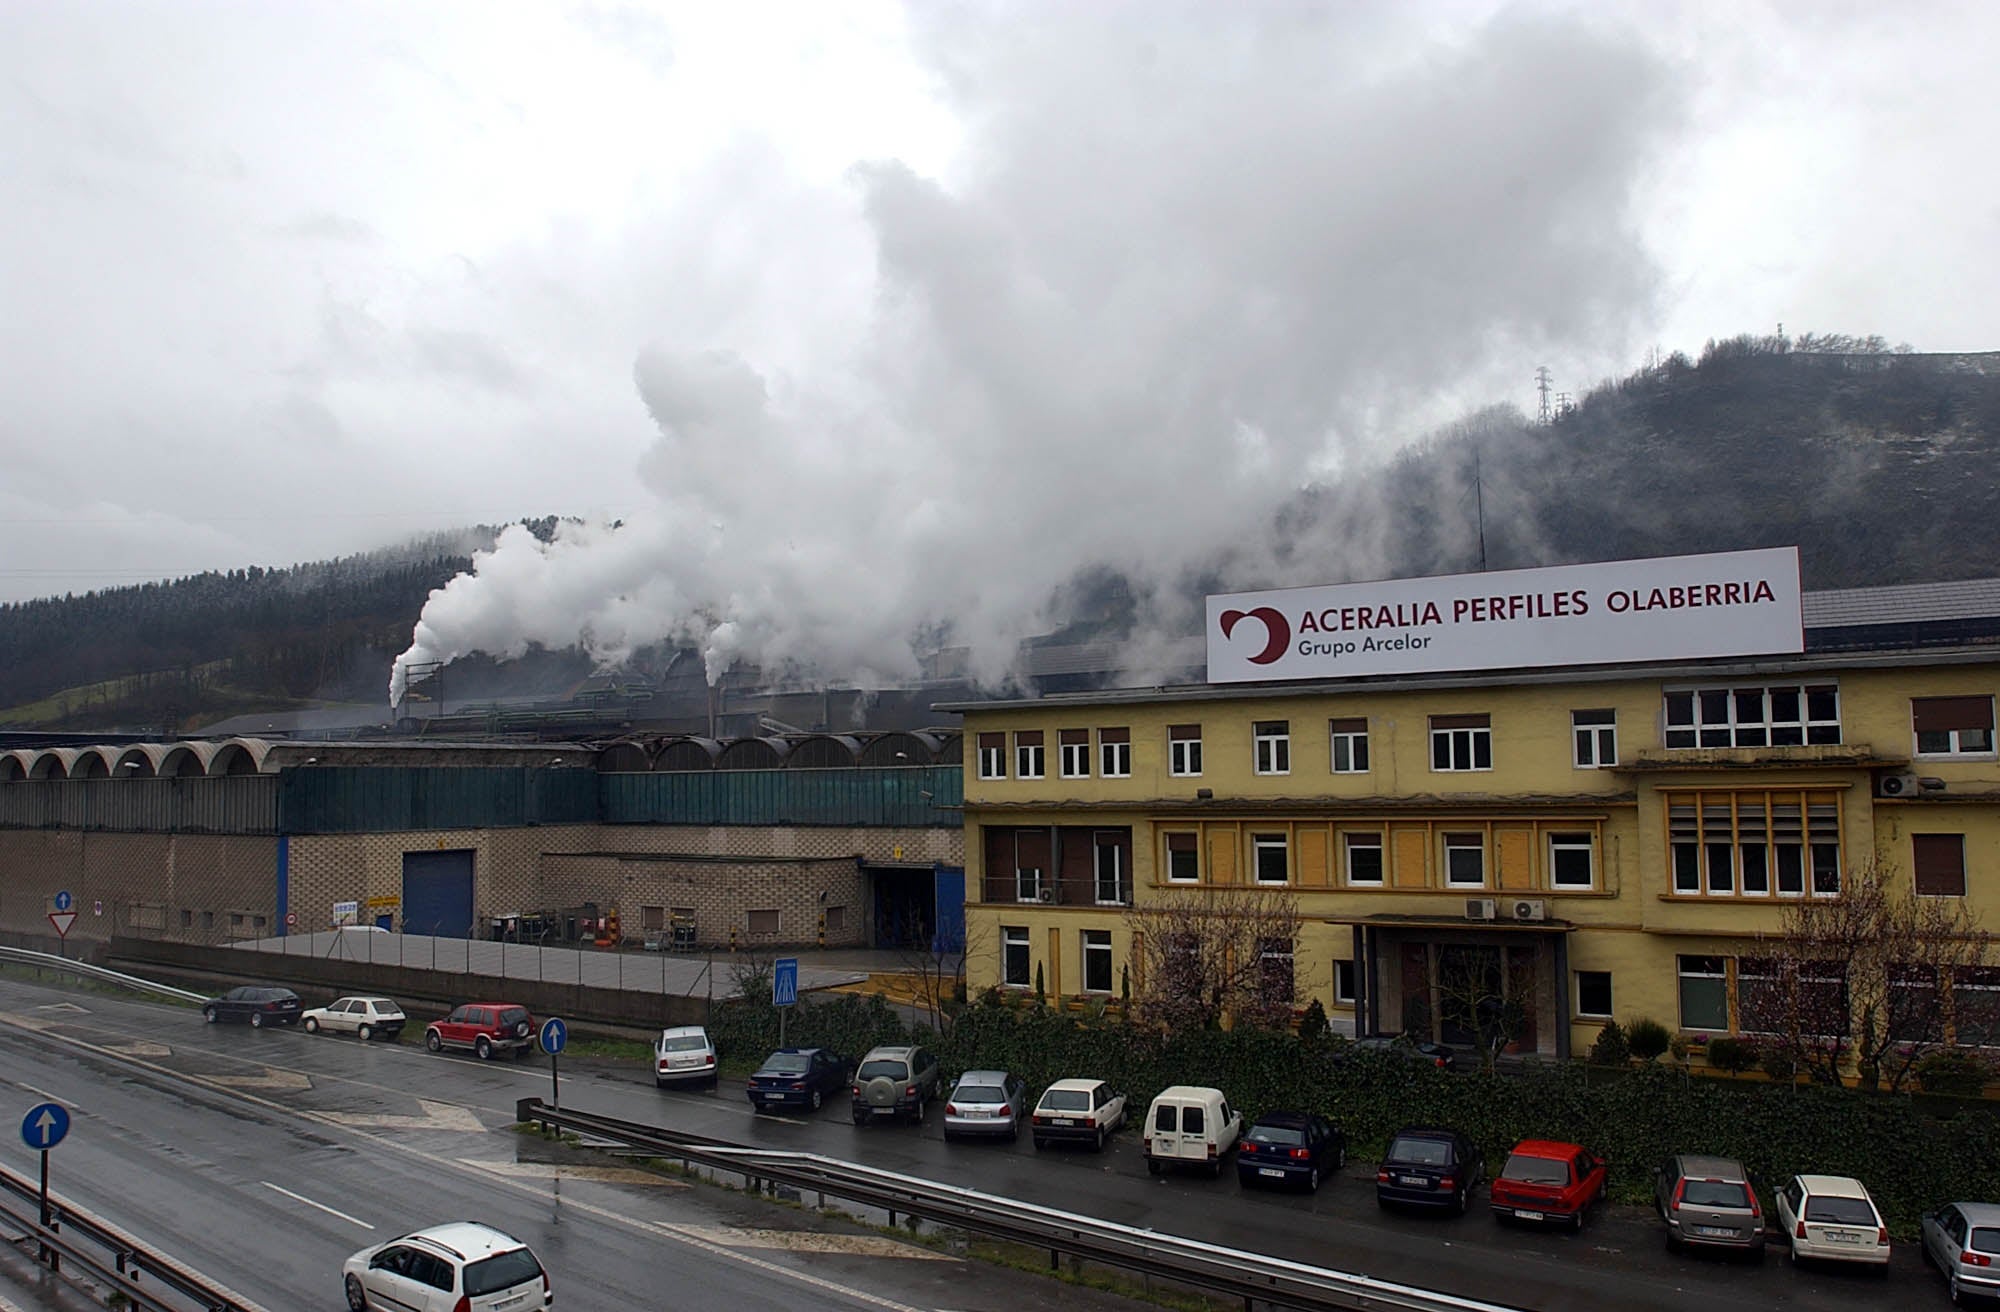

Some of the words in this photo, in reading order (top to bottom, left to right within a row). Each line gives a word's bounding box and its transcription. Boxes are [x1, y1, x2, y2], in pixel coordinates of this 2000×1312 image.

[1299, 602, 1442, 633] ACERALIA
[1454, 590, 1589, 623] PERFILES
[1607, 580, 1776, 613] OLABERRIA
[1298, 640, 1356, 658] Grupo
[1362, 633, 1431, 652] Arcelor
